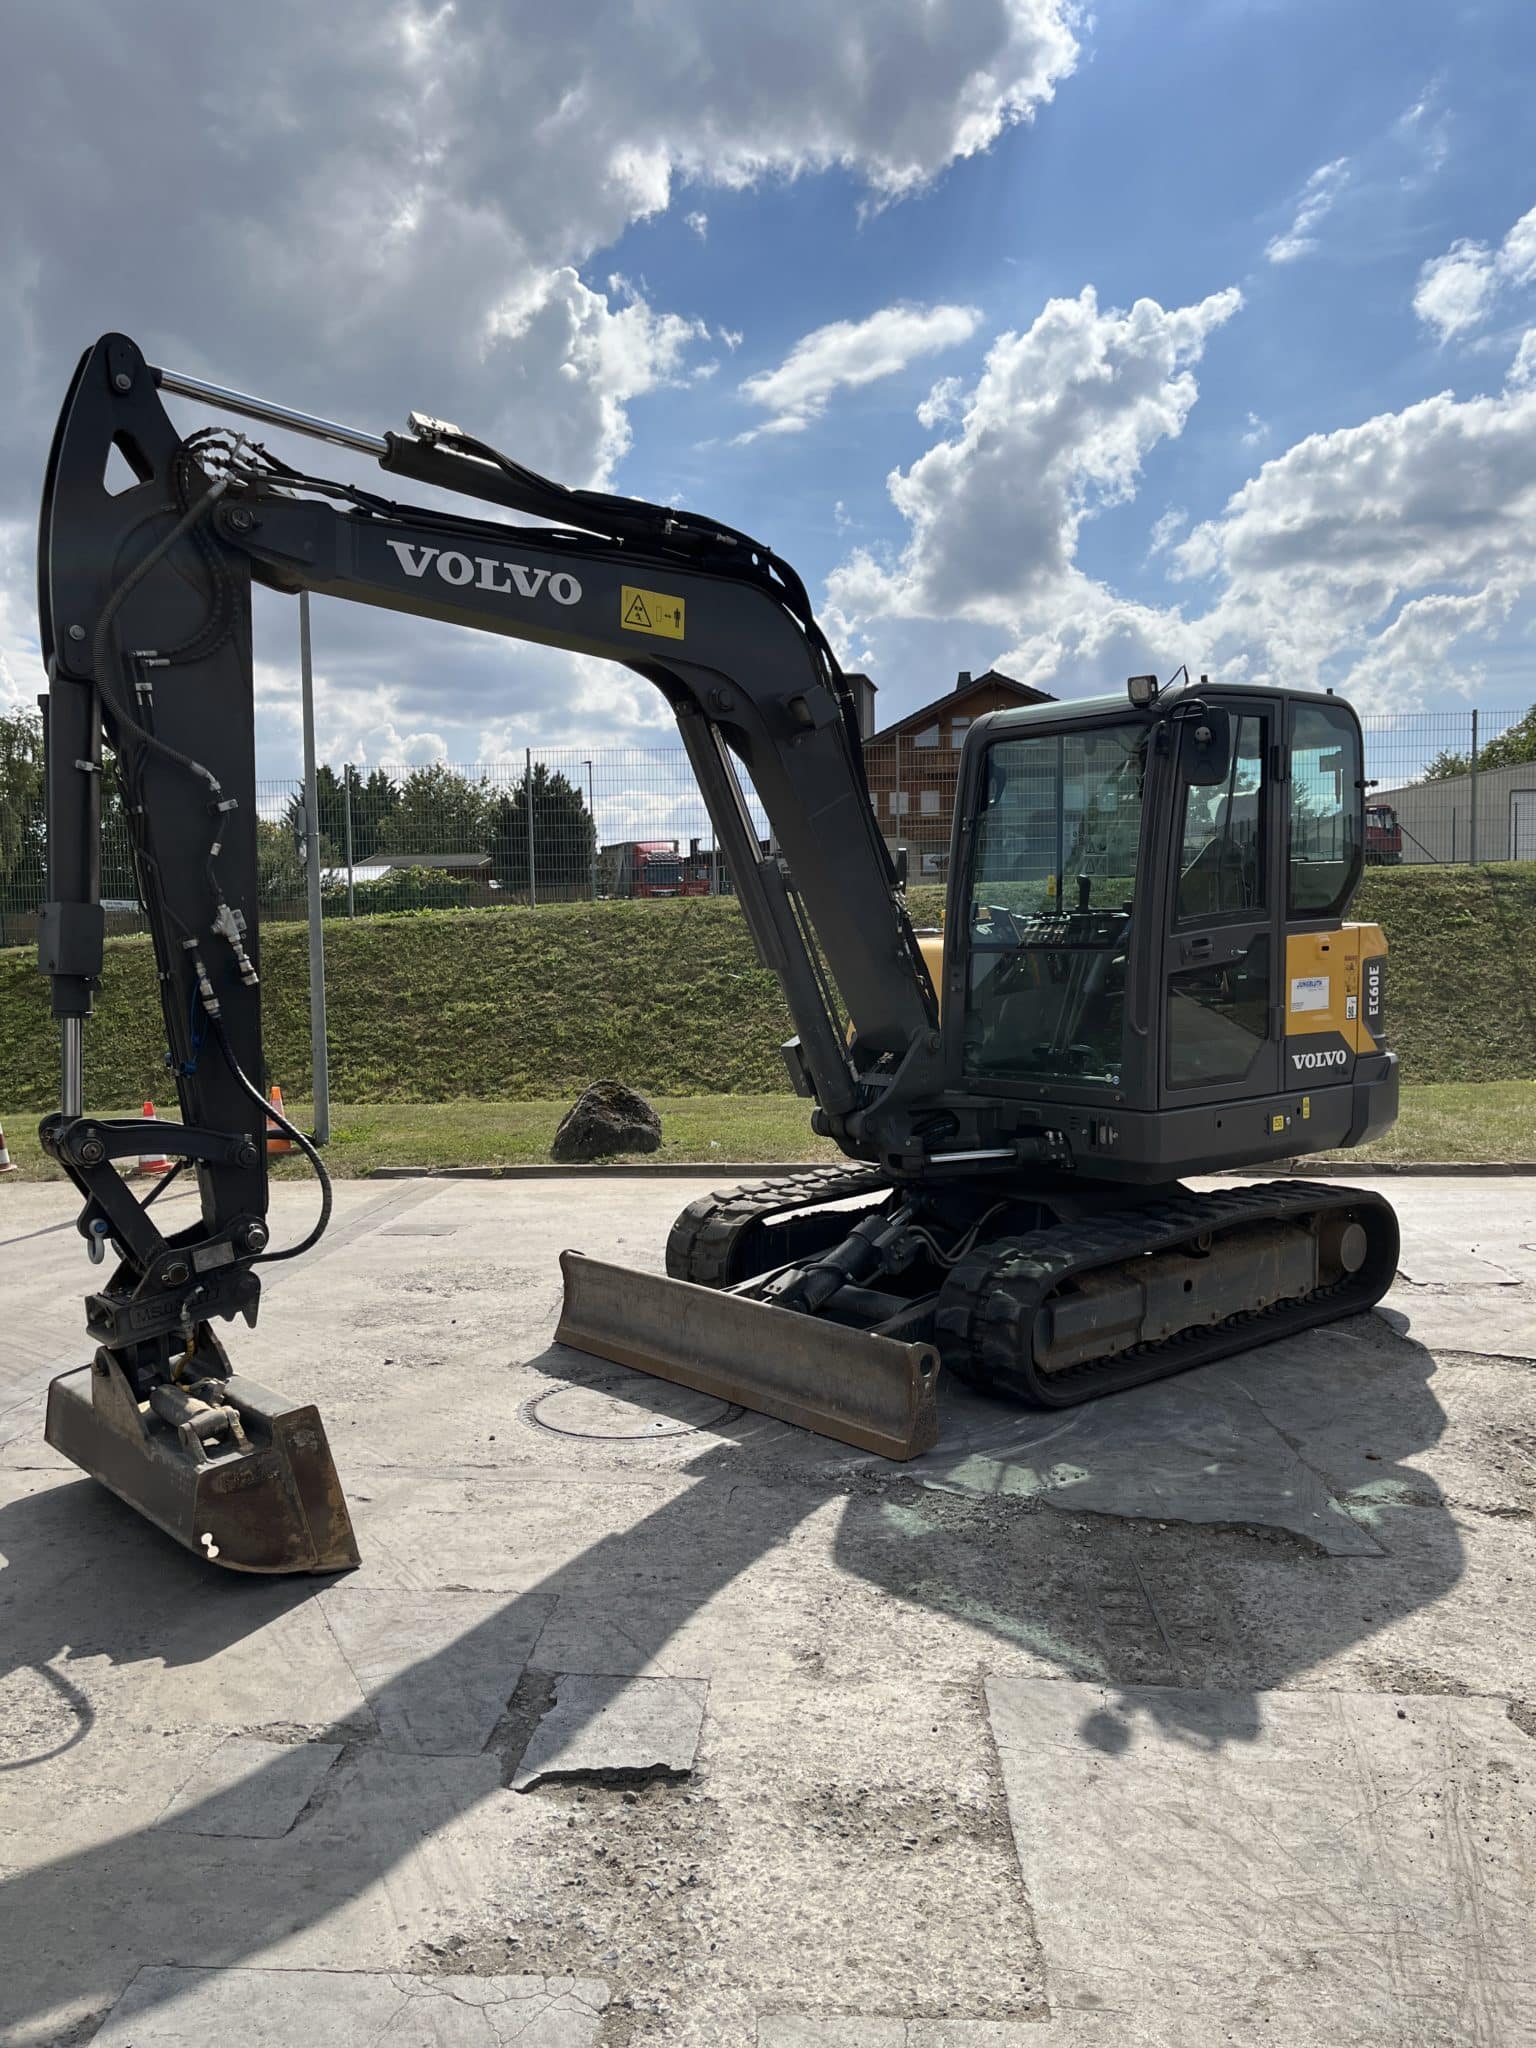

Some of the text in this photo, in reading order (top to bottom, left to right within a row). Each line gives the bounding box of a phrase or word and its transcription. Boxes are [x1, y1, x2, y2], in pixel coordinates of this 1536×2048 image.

[386, 539, 583, 606] VOLVO
[1368, 965, 1380, 1016] EC60E
[1292, 1050, 1347, 1070] VOLVO
